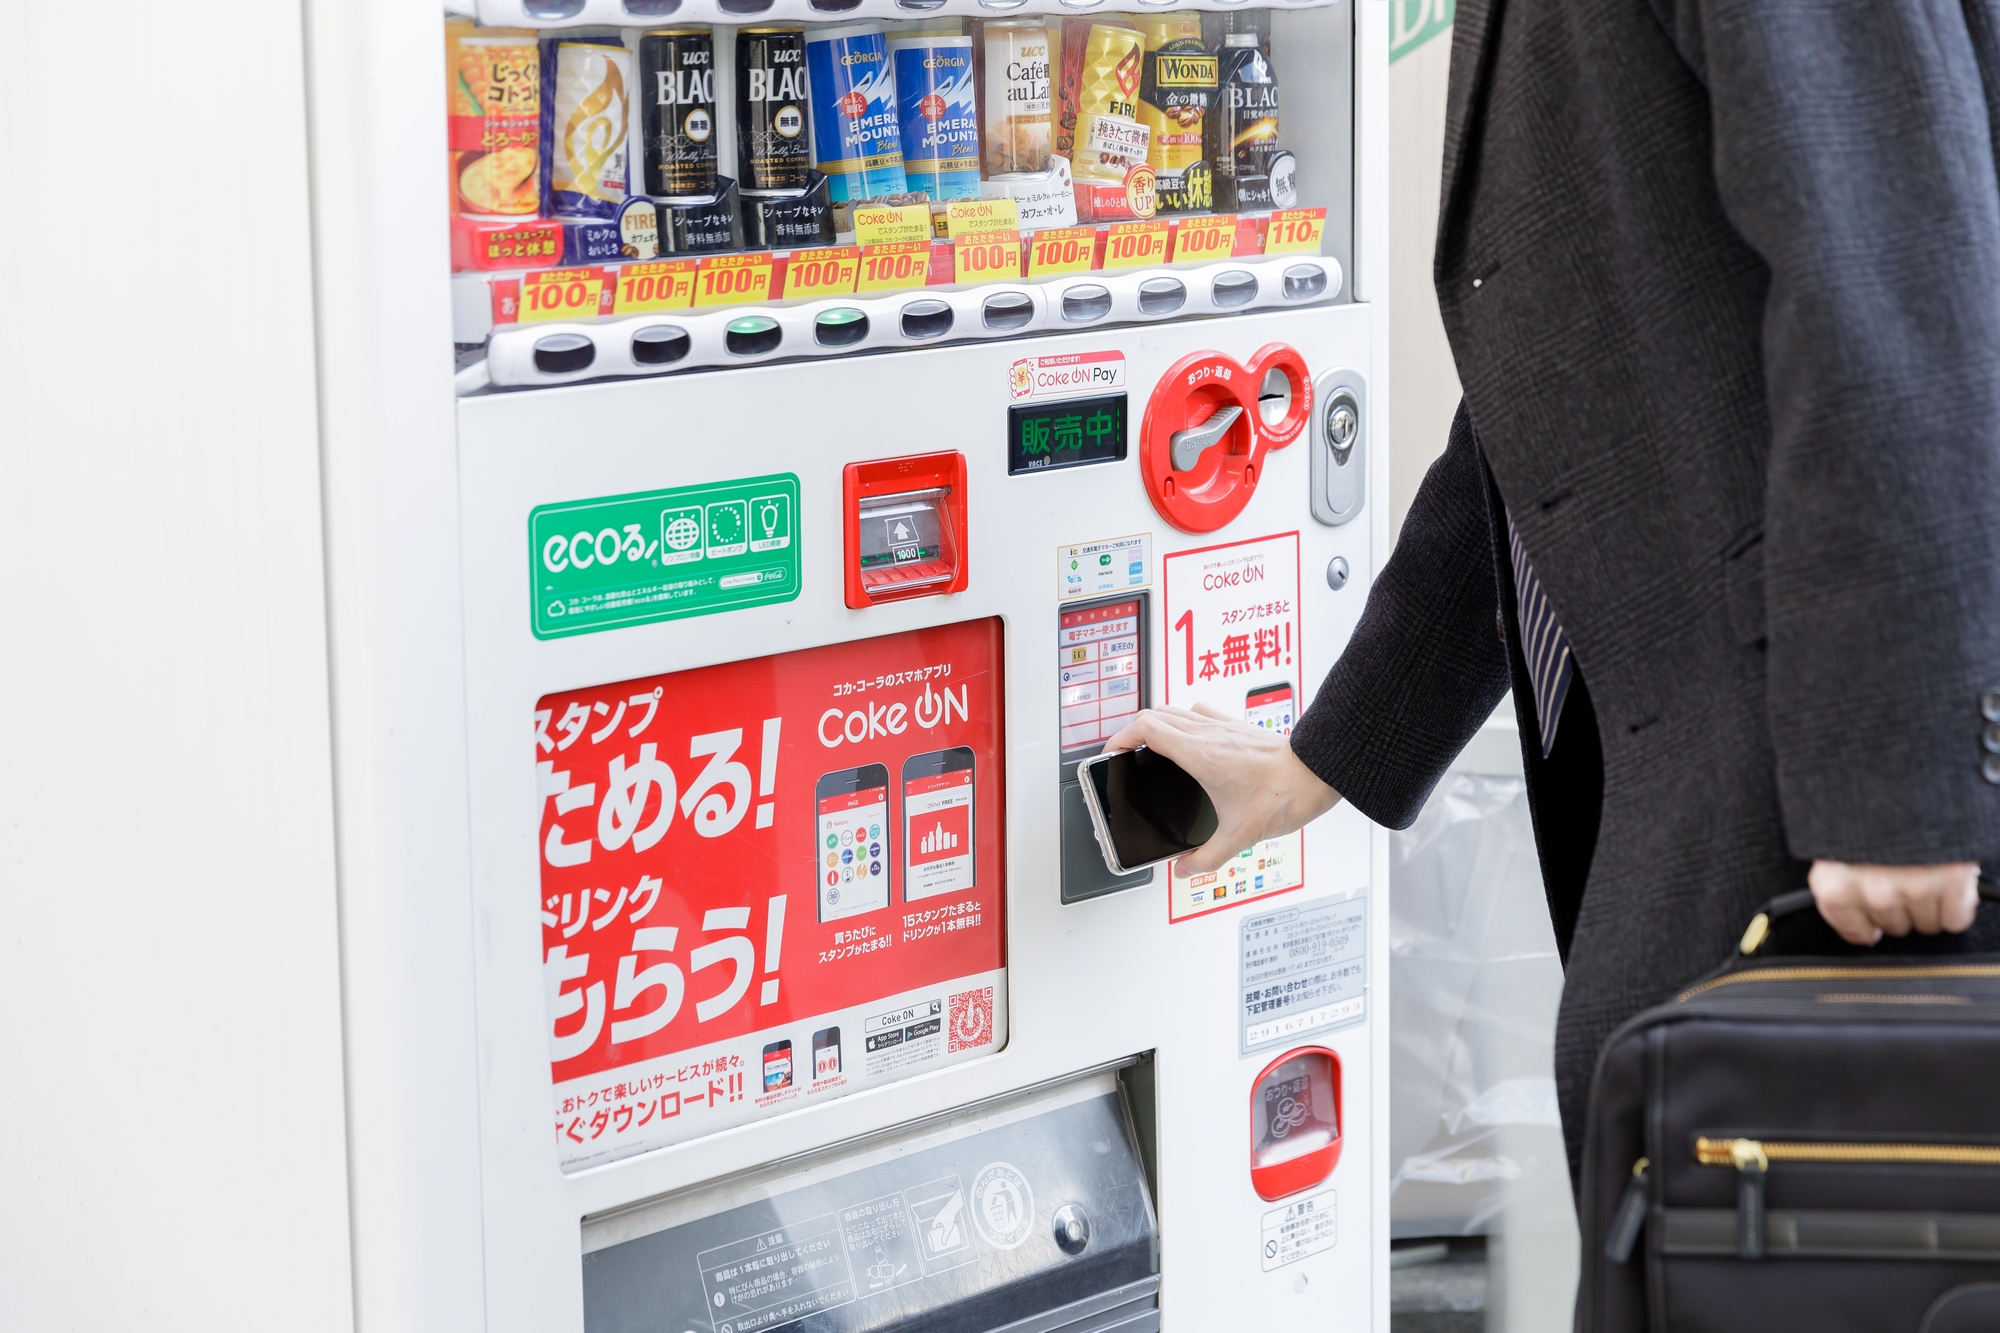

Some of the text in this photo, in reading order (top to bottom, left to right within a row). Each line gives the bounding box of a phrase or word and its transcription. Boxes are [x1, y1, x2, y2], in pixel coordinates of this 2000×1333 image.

[1006, 61, 1043, 82] Café
[1161, 58, 1214, 80] WONDA
[655, 68, 716, 105] BLAC
[1007, 80, 1050, 101] au Lai
[1165, 92, 1208, 107] 金の微糖
[848, 114, 899, 133] EMERA
[1013, 191, 1073, 204] ヒーとミルクのハーモニー
[624, 212, 657, 231] FIRE
[763, 206, 824, 218] シャープなキレ
[857, 210, 903, 226] Coke ON
[950, 203, 993, 219] Coke ON
[586, 229, 617, 242] ミルクの
[685, 231, 731, 245] 香料無添加
[775, 223, 820, 236] 香料無添加
[1180, 228, 1231, 253] 100円
[1272, 220, 1319, 245] 110円
[487, 239, 556, 259] ほっと休憩
[587, 243, 619, 257] おいしさ
[1035, 240, 1091, 266] 100円
[1110, 233, 1163, 259] 100円
[865, 254, 925, 282] 100円
[959, 244, 1017, 272] 100円
[702, 267, 766, 296] 100円
[791, 260, 853, 288] 100円
[526, 282, 597, 311] 100円
[622, 275, 689, 303] 100円
[1037, 366, 1118, 387] Coke ON Pay
[1187, 365, 1232, 385] おつり・返却
[1021, 409, 1113, 456] 販売中
[896, 547, 917, 560] 1000
[1203, 563, 1264, 591] Coke ON
[1221, 600, 1290, 625] スタンプたまると
[1068, 621, 1129, 641] 電子マネー使えます
[833, 663, 952, 697] コカ・コーラのスマホアプリ
[534, 685, 664, 754] スタンプ
[817, 682, 969, 749] Coke ON
[902, 900, 982, 929] 15スタンプたまると
[834, 924, 877, 946] 買うたびに
[1289, 934, 1350, 958] 0800-919-0509
[881, 1014, 901, 1026] Coke
[902, 1009, 914, 1020] ON
[913, 1028, 929, 1036] Google
[975, 1168, 1023, 1199] のんだあとは
[844, 1198, 900, 1223] 商品の取り出し方
[767, 1233, 784, 1247] 注意
[849, 1230, 904, 1252] 取り出してください
[988, 1217, 1030, 1244] リサイクル
